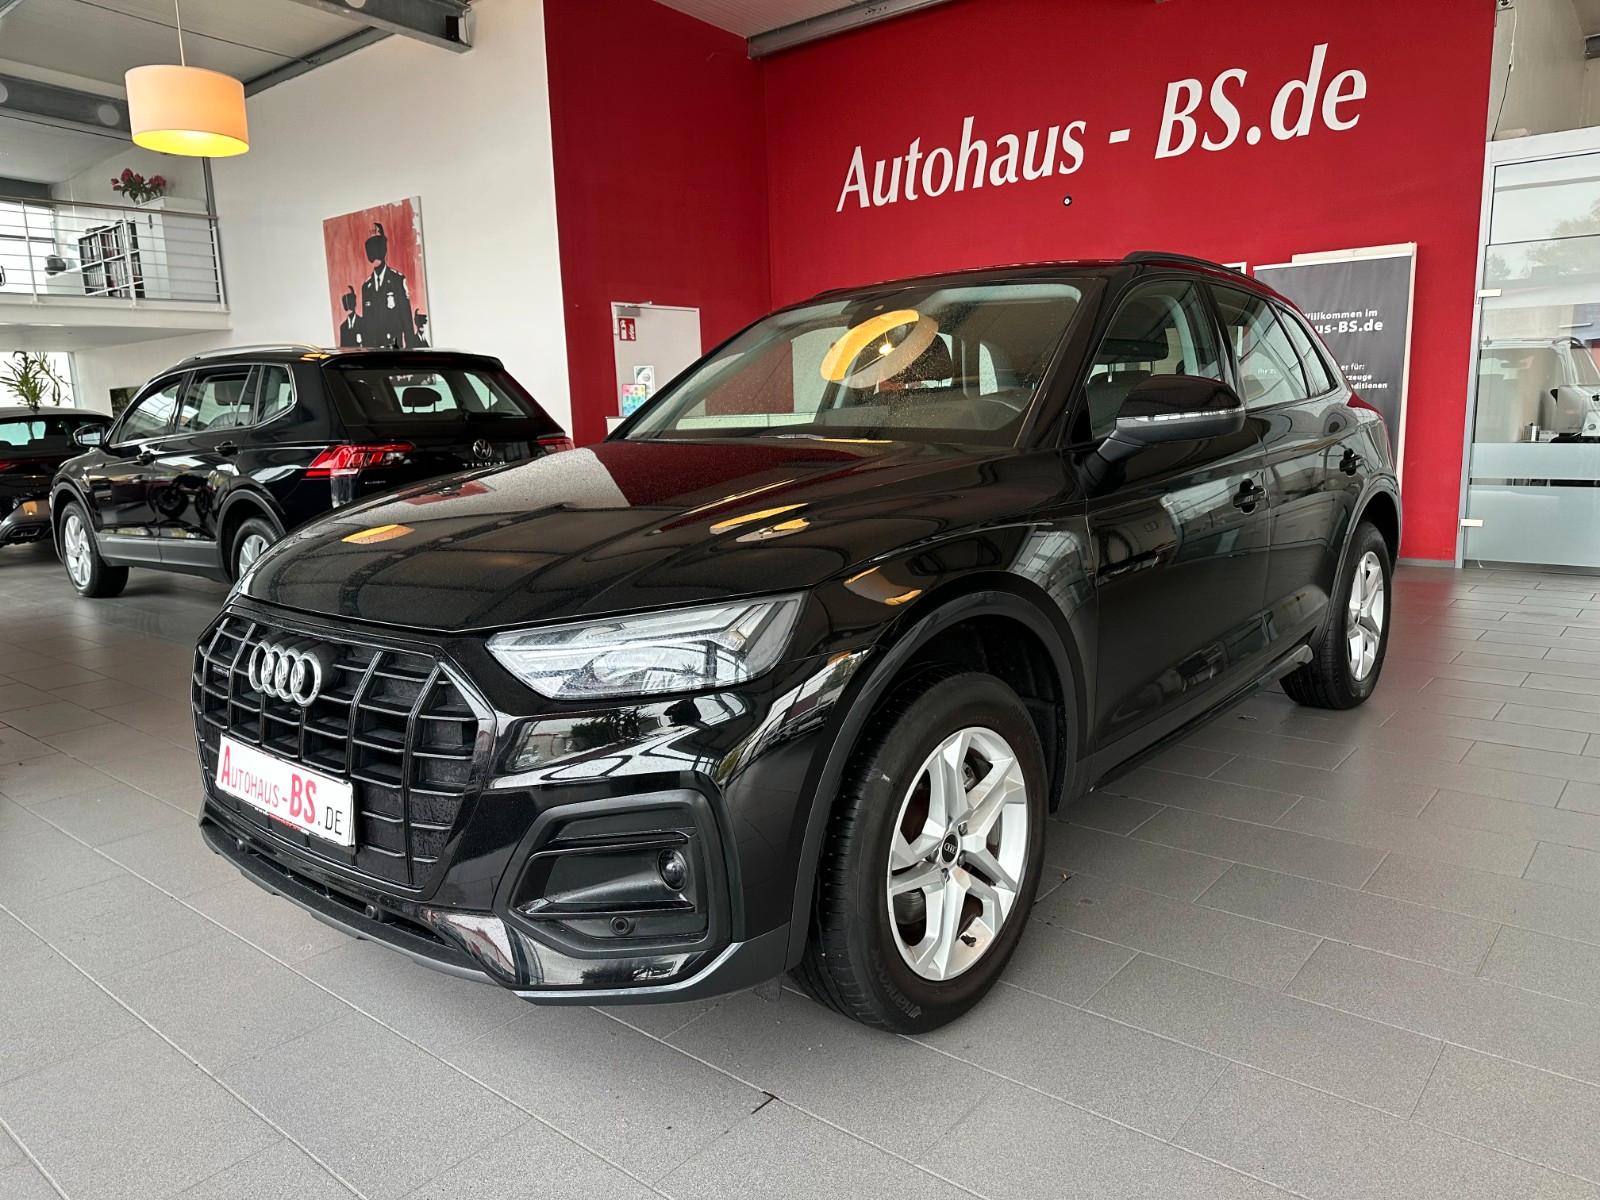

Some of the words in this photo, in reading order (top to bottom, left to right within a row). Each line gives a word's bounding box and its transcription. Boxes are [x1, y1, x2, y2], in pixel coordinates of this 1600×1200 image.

[836, 115, 1087, 213] Autohaus
[1154, 43, 1367, 160] BS.de
[1365, 308, 1378, 318] im
[1351, 362, 1365, 370] für:
